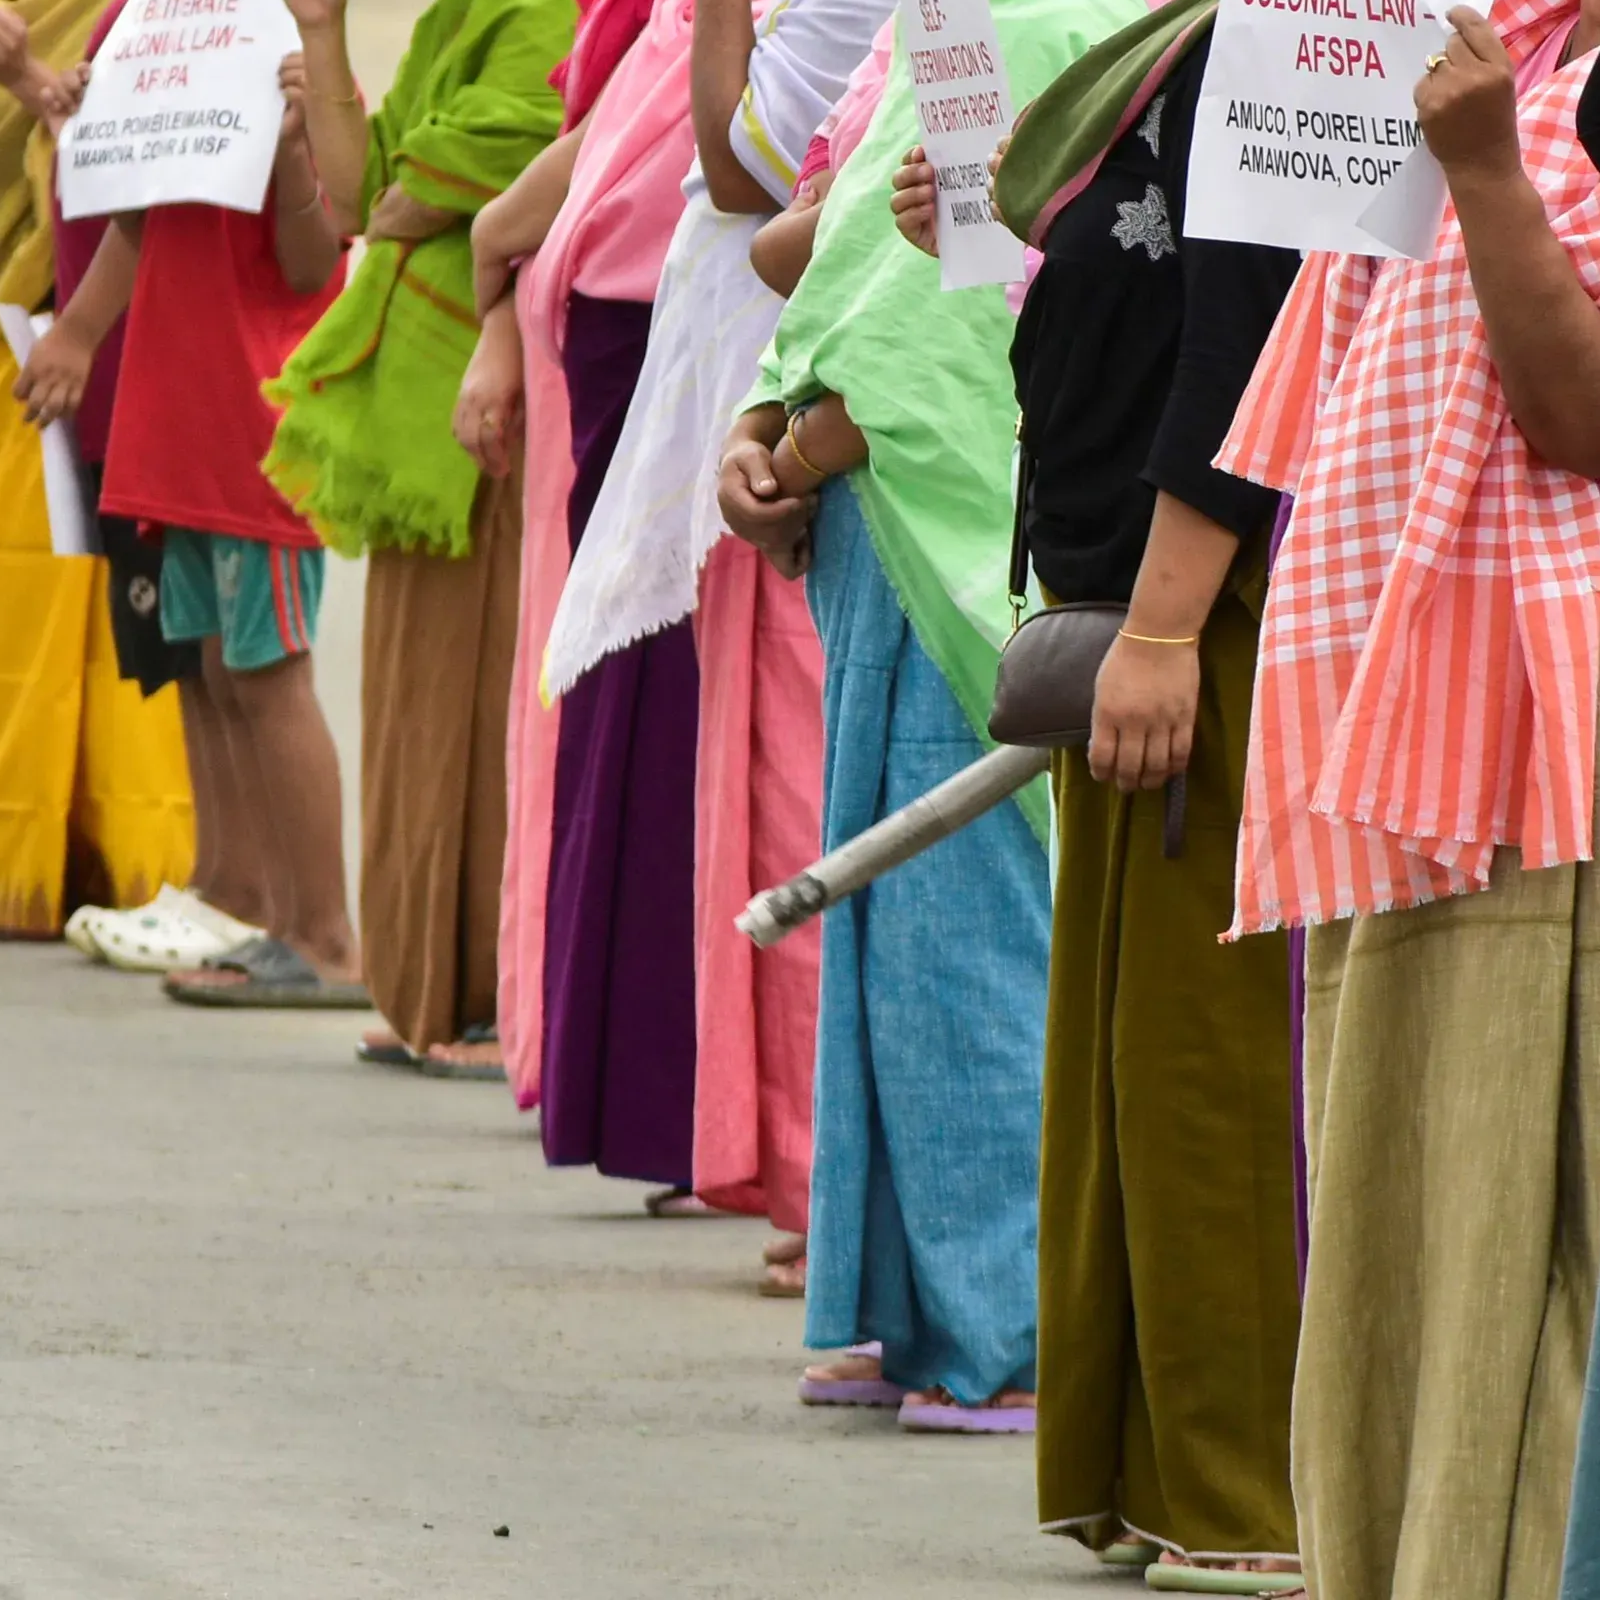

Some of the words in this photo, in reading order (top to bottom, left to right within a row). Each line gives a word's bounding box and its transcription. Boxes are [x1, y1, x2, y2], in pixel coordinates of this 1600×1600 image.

[191, 23, 238, 51] LAW
[976, 40, 995, 75] IS
[1295, 33, 1386, 79] AFSPA
[939, 95, 969, 132] BIRTH
[967, 90, 1005, 128] RIGHT
[1226, 100, 1291, 142] AMUCO,
[1296, 109, 1367, 143] POIREI
[1371, 117, 1422, 148] LEIM
[1239, 143, 1342, 188] AMAWOVA,
